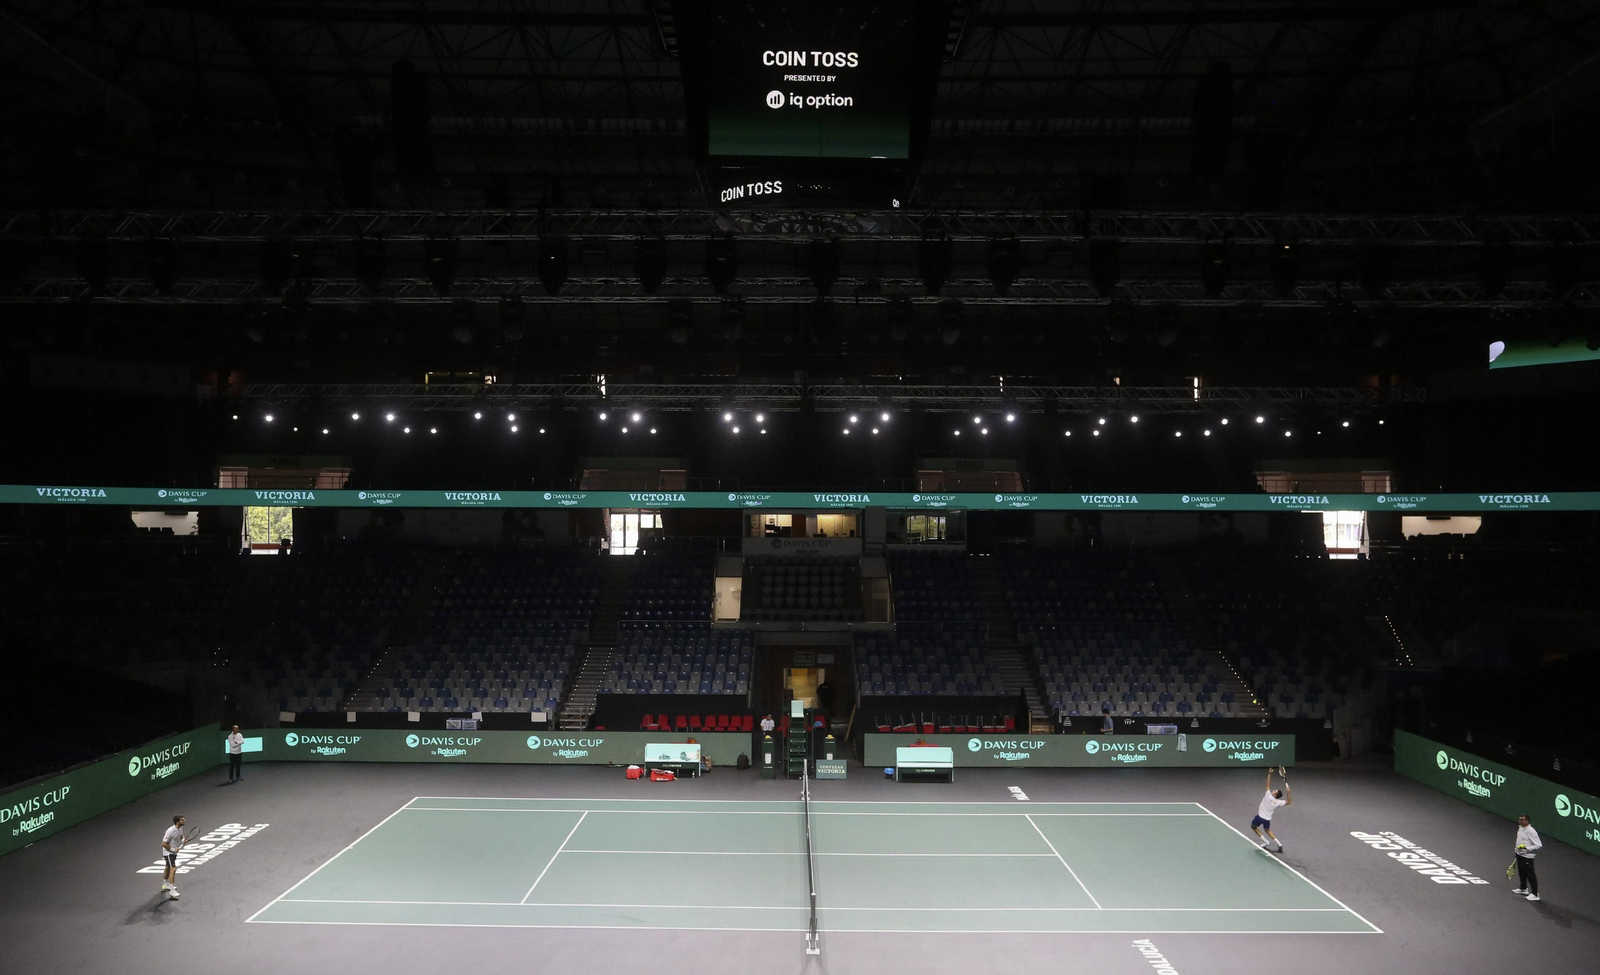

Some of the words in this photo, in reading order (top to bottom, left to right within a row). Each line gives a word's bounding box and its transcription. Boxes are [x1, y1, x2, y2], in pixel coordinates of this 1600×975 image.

[763, 50, 806, 66] COIN
[811, 52, 858, 68] TOSS
[790, 92, 803, 108] iq
[806, 93, 853, 109] option
[721, 186, 744, 203] COIN
[746, 180, 782, 196] TOSS
[36, 488, 106, 497] VICTORIA
[255, 492, 315, 500] VICTORIA
[1479, 495, 1550, 503] VICTORIA
[784, 539, 810, 547] DAVIS
[812, 539, 831, 547] CUP
[302, 735, 333, 744] DAVIS
[336, 736, 361, 745] CUP
[422, 736, 454, 745] DAVIS
[456, 736, 482, 746] CUP
[544, 738, 576, 747] DAVIS
[578, 738, 604, 747] CUP
[317, 746, 346, 755] Rakuten
[985, 741, 1017, 750] DAVIS
[1020, 741, 1045, 750] CUP
[1102, 743, 1135, 752] DAVIS
[1138, 743, 1163, 752] CUP
[1219, 741, 1252, 750] DAVIS
[1254, 741, 1279, 750] CUP
[143, 748, 170, 769] DAVIS
[172, 742, 191, 758] CUP
[437, 747, 466, 757] Rakuten
[559, 749, 588, 758] Rakuten
[1000, 751, 1030, 760] Rakuten
[1234, 751, 1264, 761] Rakuten
[1117, 753, 1147, 762] Rakuten
[156, 761, 179, 778] Rakuten
[1450, 757, 1479, 779] DAVIS
[1481, 770, 1506, 786] CUP
[1458, 780, 1463, 788] by
[1463, 778, 1491, 798] Rakuten
[0, 797, 40, 823] DAVIS
[44, 786, 70, 806] CUP
[20, 811, 54, 833] Rakuten
[200, 823, 247, 841] CUP
[1586, 830, 1592, 840] by
[1350, 831, 1402, 850] CUP
[1388, 852, 1469, 884] DAVIS
